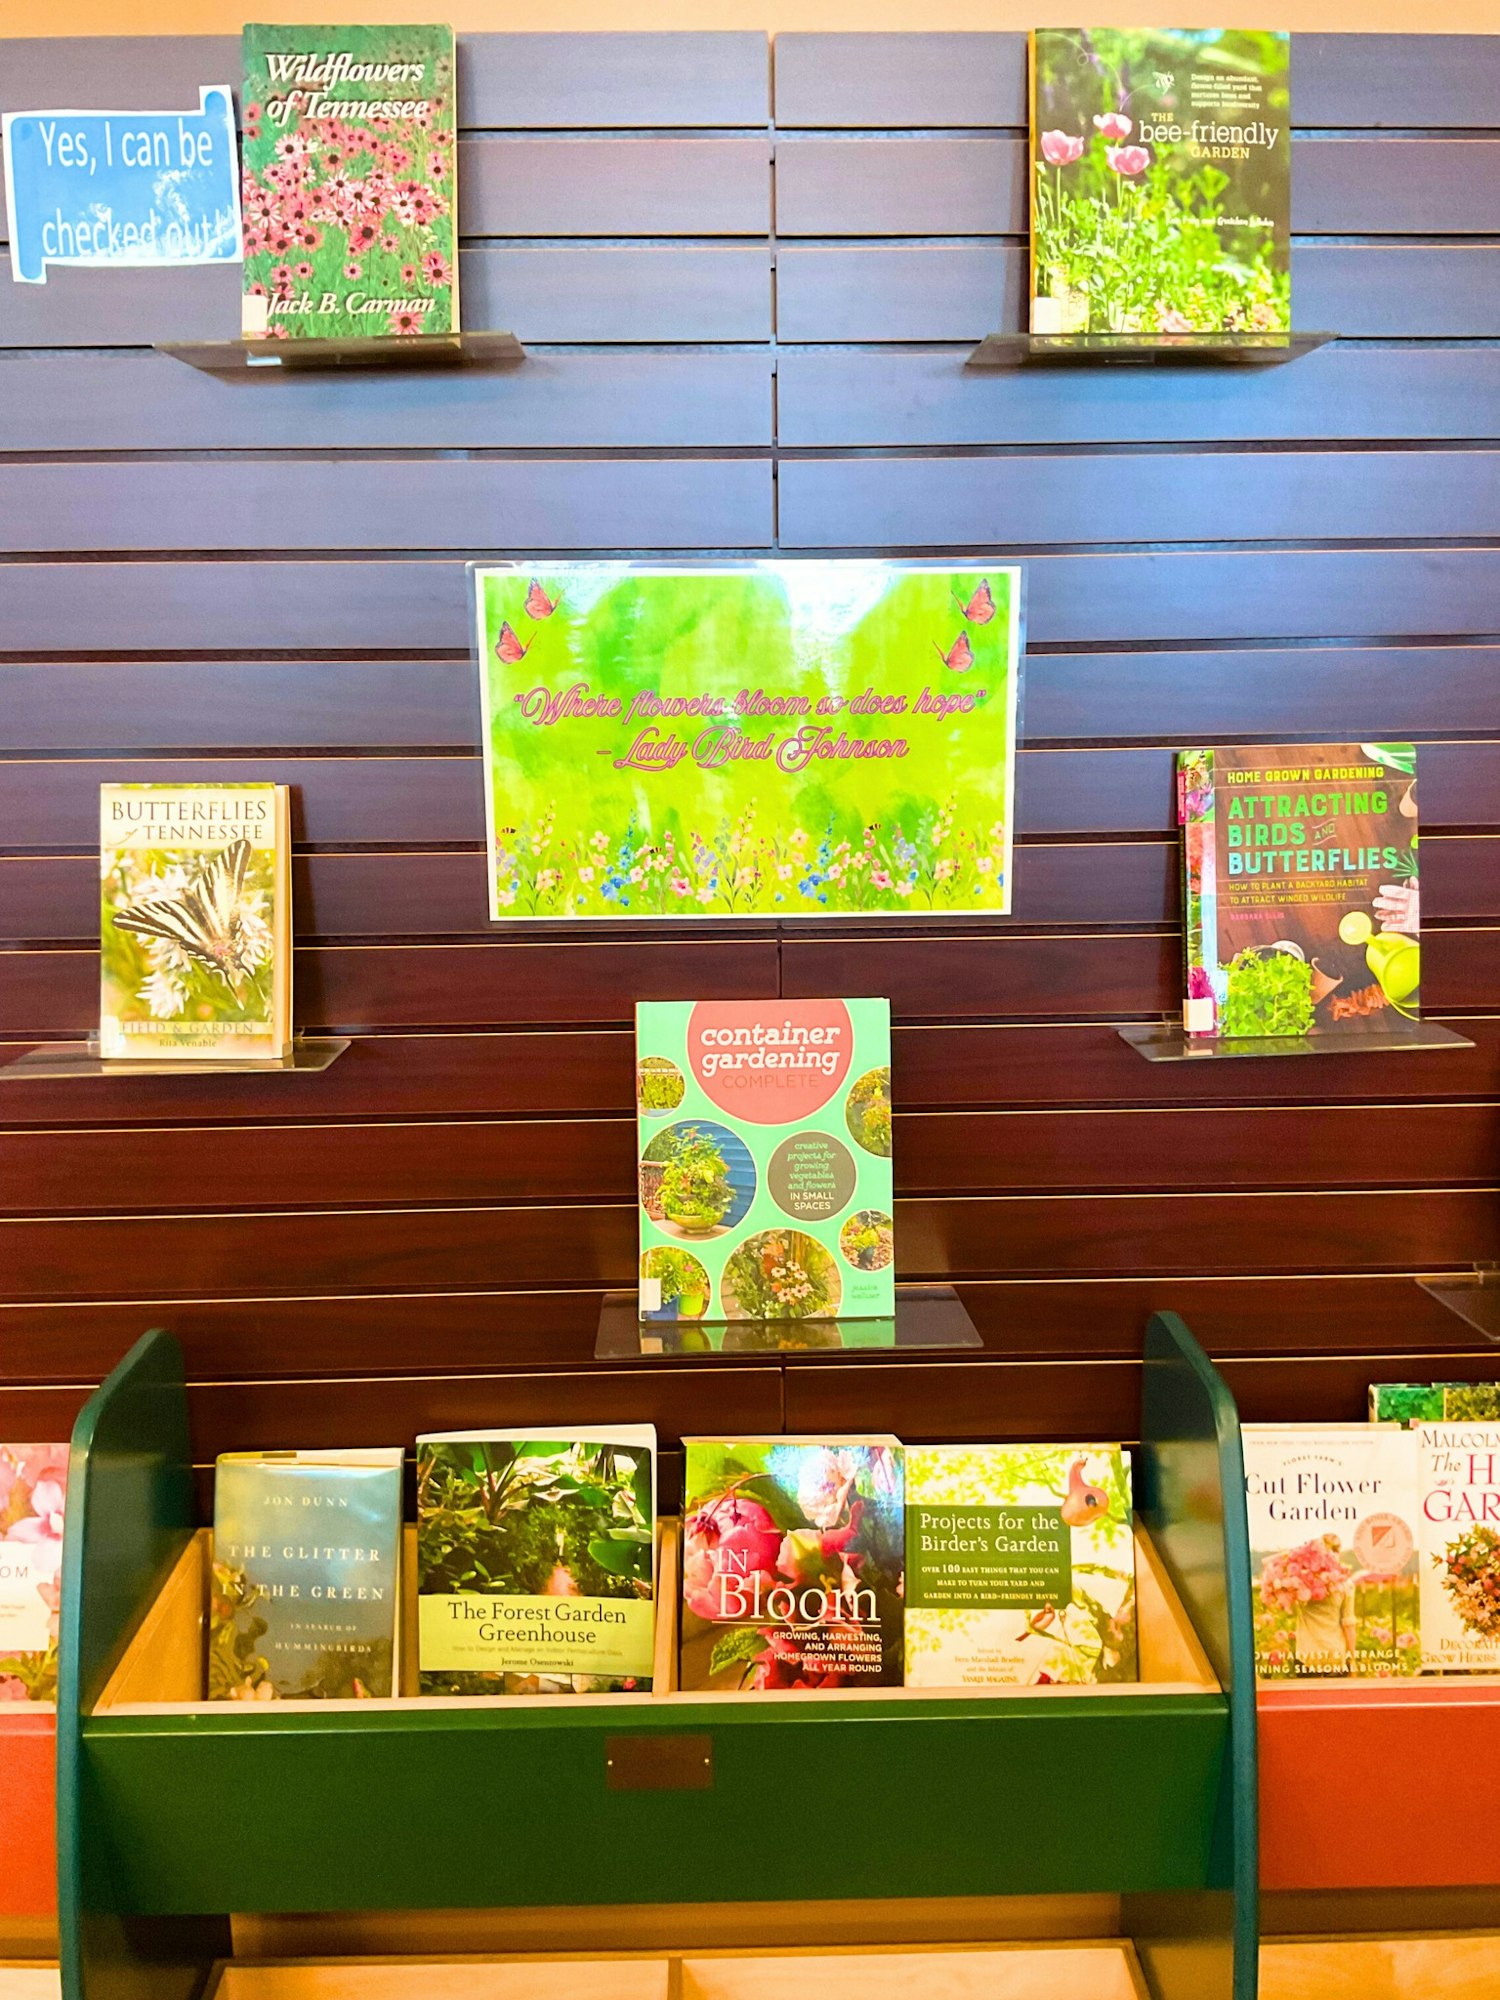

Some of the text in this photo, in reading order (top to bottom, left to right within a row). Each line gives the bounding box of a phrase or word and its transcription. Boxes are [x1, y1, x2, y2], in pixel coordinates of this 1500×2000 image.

[265, 53, 425, 90] Wildflowers
[267, 89, 429, 128] of Tennessee
[1151, 113, 1174, 122] THE
[1139, 120, 1279, 149] bee-friendly
[39, 117, 213, 176] Yes, I can be
[1190, 147, 1250, 159] GARDEN
[42, 208, 156, 256] checked
[267, 293, 435, 317] Jack B. Carman
[622, 690, 726, 725] flowers
[733, 688, 812, 716] bloom
[816, 695, 849, 715] so
[850, 687, 908, 714] does
[613, 725, 910, 773] Lady Bird Johnson
[1227, 766, 1384, 783] HOME GROWN GARDENING
[112, 801, 267, 820] BUTTERFLIES
[1228, 791, 1388, 820] ATTRACTING
[143, 825, 263, 840] TENNESSEE
[1228, 823, 1336, 847] BIRDS AND
[1228, 847, 1399, 875] BUTTERFLIES
[1229, 879, 1368, 891] HOW TO PLANT A BACKYARD HABITAT
[1230, 893, 1346, 904] TO ATTRACT WINGED WILDLIFE
[122, 1023, 166, 1033] FIELD
[189, 1023, 253, 1033] GARDEN
[700, 1021, 841, 1046] container
[159, 1038, 217, 1048] Rita Venable
[701, 1047, 840, 1078] gardening
[721, 1074, 819, 1089] COMPLETE
[794, 1142, 828, 1150] creative
[787, 1150, 836, 1162] projects for
[794, 1162, 829, 1172] growing
[789, 1172, 834, 1181] vegetables
[788, 1181, 836, 1191] and flowers
[790, 1192, 834, 1200] IN SMALL
[794, 1201, 831, 1210] SPACES
[1432, 1452, 1461, 1472] The
[1246, 1472, 1382, 1494] Cut Flower
[264, 1497, 348, 1507] JON DUNN
[1269, 1499, 1357, 1520] Garden
[921, 1513, 1059, 1534] Projects for the
[995, 1536, 1059, 1553] Garden
[228, 1545, 380, 1561] THE GLITTER
[716, 1549, 748, 1573] IN
[942, 1564, 960, 1573] 100
[222, 1584, 384, 1600] IN THE GREEN
[716, 1570, 881, 1622] Bloom
[448, 1601, 626, 1624] The Forest Garden
[479, 1624, 596, 1644] Greenhouse
[773, 1631, 882, 1642] GROWING, HARVESTING,
[275, 1642, 371, 1652] HUMMINGBIRDS
[827, 1643, 882, 1652] ARRANGING
[1278, 1650, 1329, 1660] HARVEST
[774, 1653, 882, 1662] HOMEGROWN FLOWERS
[802, 1663, 882, 1672] ALL YEAR ROUND
[1295, 1664, 1356, 1673] SEASONAL
[1360, 1663, 1408, 1672] BLOOMS
